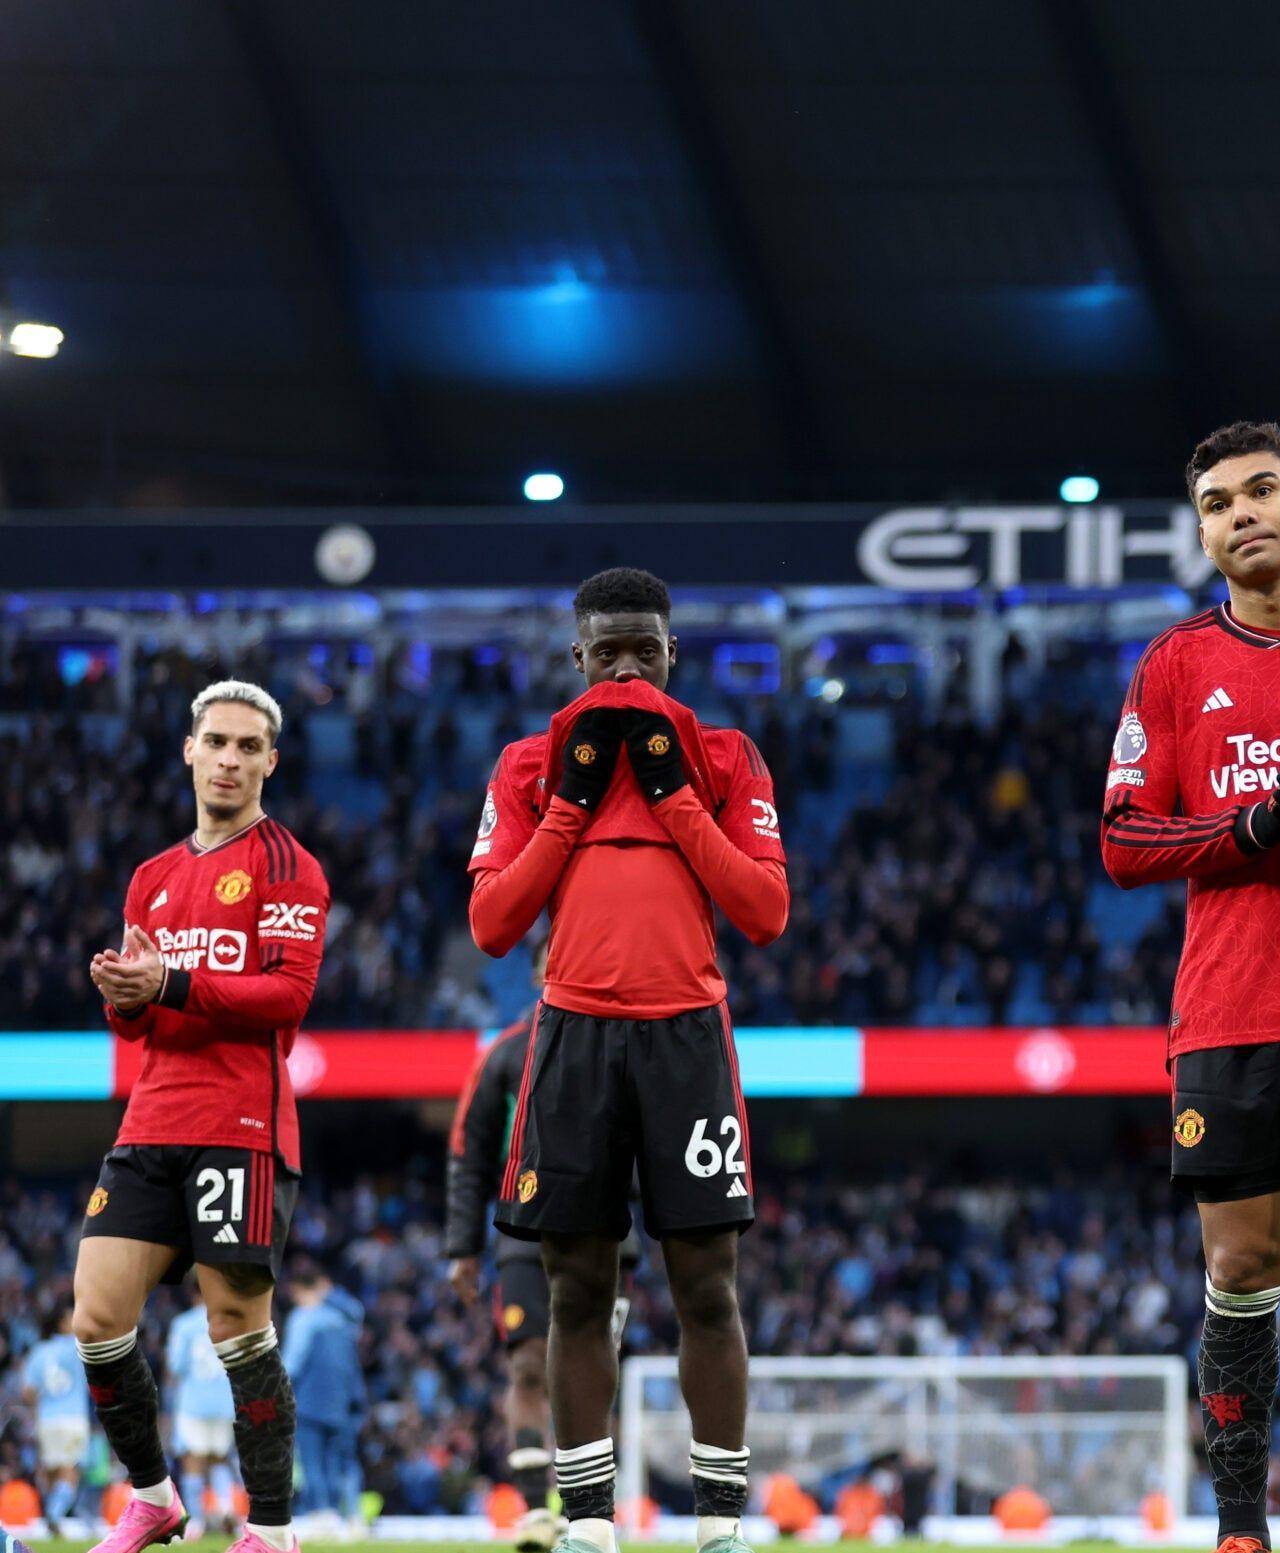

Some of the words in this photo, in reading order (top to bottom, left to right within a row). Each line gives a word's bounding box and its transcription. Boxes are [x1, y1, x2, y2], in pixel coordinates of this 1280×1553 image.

[258, 902, 319, 933] DXC
[155, 926, 208, 952] Team
[685, 1115, 746, 1178] 62
[196, 1168, 245, 1222] 21
